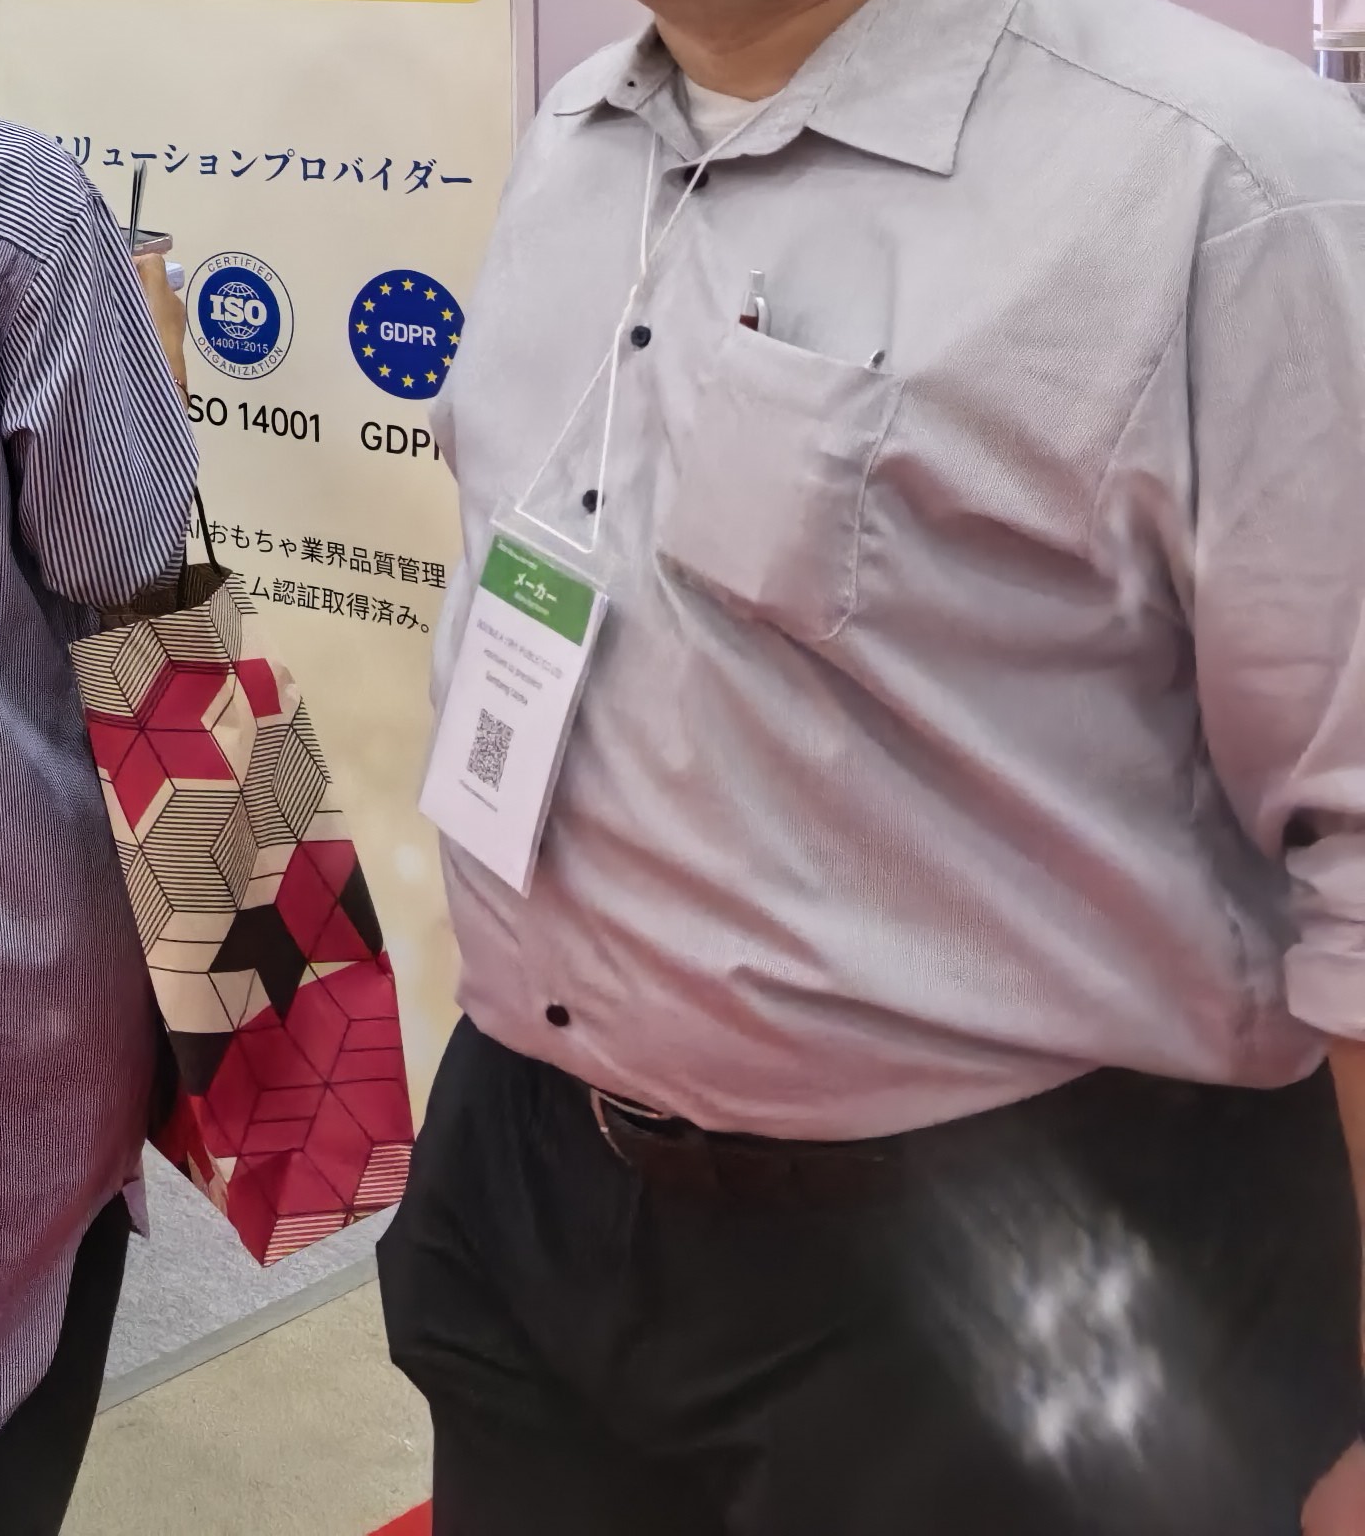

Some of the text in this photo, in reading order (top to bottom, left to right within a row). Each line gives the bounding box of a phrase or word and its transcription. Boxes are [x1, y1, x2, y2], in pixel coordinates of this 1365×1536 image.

[207, 256, 273, 282] CERTIFIED
[209, 294, 268, 326] ISO
[210, 336, 269, 354] 14001:2015
[379, 321, 437, 347] GDPR
[198, 336, 284, 376] ORGANIZATION
[187, 393, 322, 444] SO 14001
[208, 520, 447, 590] おもちゃ業界品質管理
